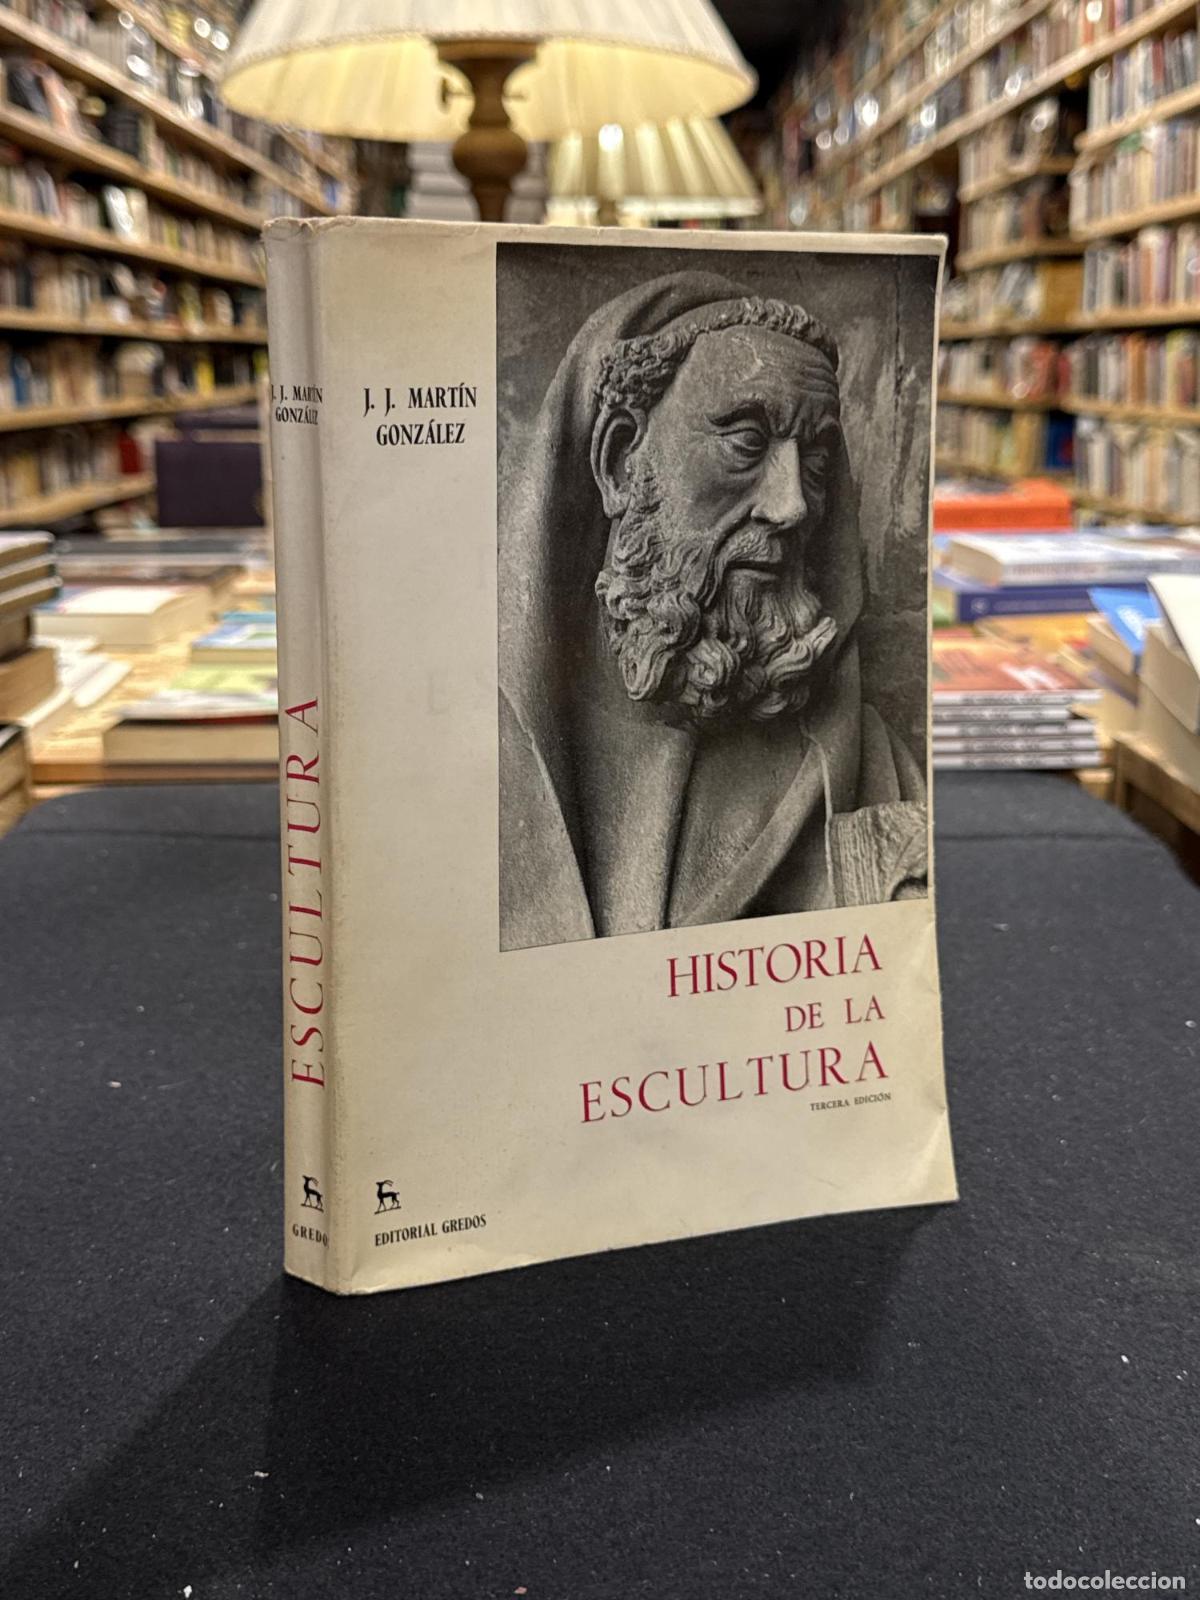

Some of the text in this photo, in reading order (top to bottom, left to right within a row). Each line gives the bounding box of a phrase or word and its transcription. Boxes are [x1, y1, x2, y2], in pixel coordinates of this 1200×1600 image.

[280, 385, 288, 404] J.
[363, 383, 477, 417] J. J. MARTÍN
[376, 419, 466, 446] GONZÁLEZ
[285, 696, 325, 1090] ESCULTURA
[666, 933, 882, 998] HISTORIA
[784, 995, 886, 1032] DE LA
[579, 1040, 889, 1123] ESCULTURA
[810, 1092, 891, 1111] TERCERA EDICIÓN
[292, 1223, 329, 1249] GREDO
[374, 1213, 487, 1247] EDITORIAL GREDOS
